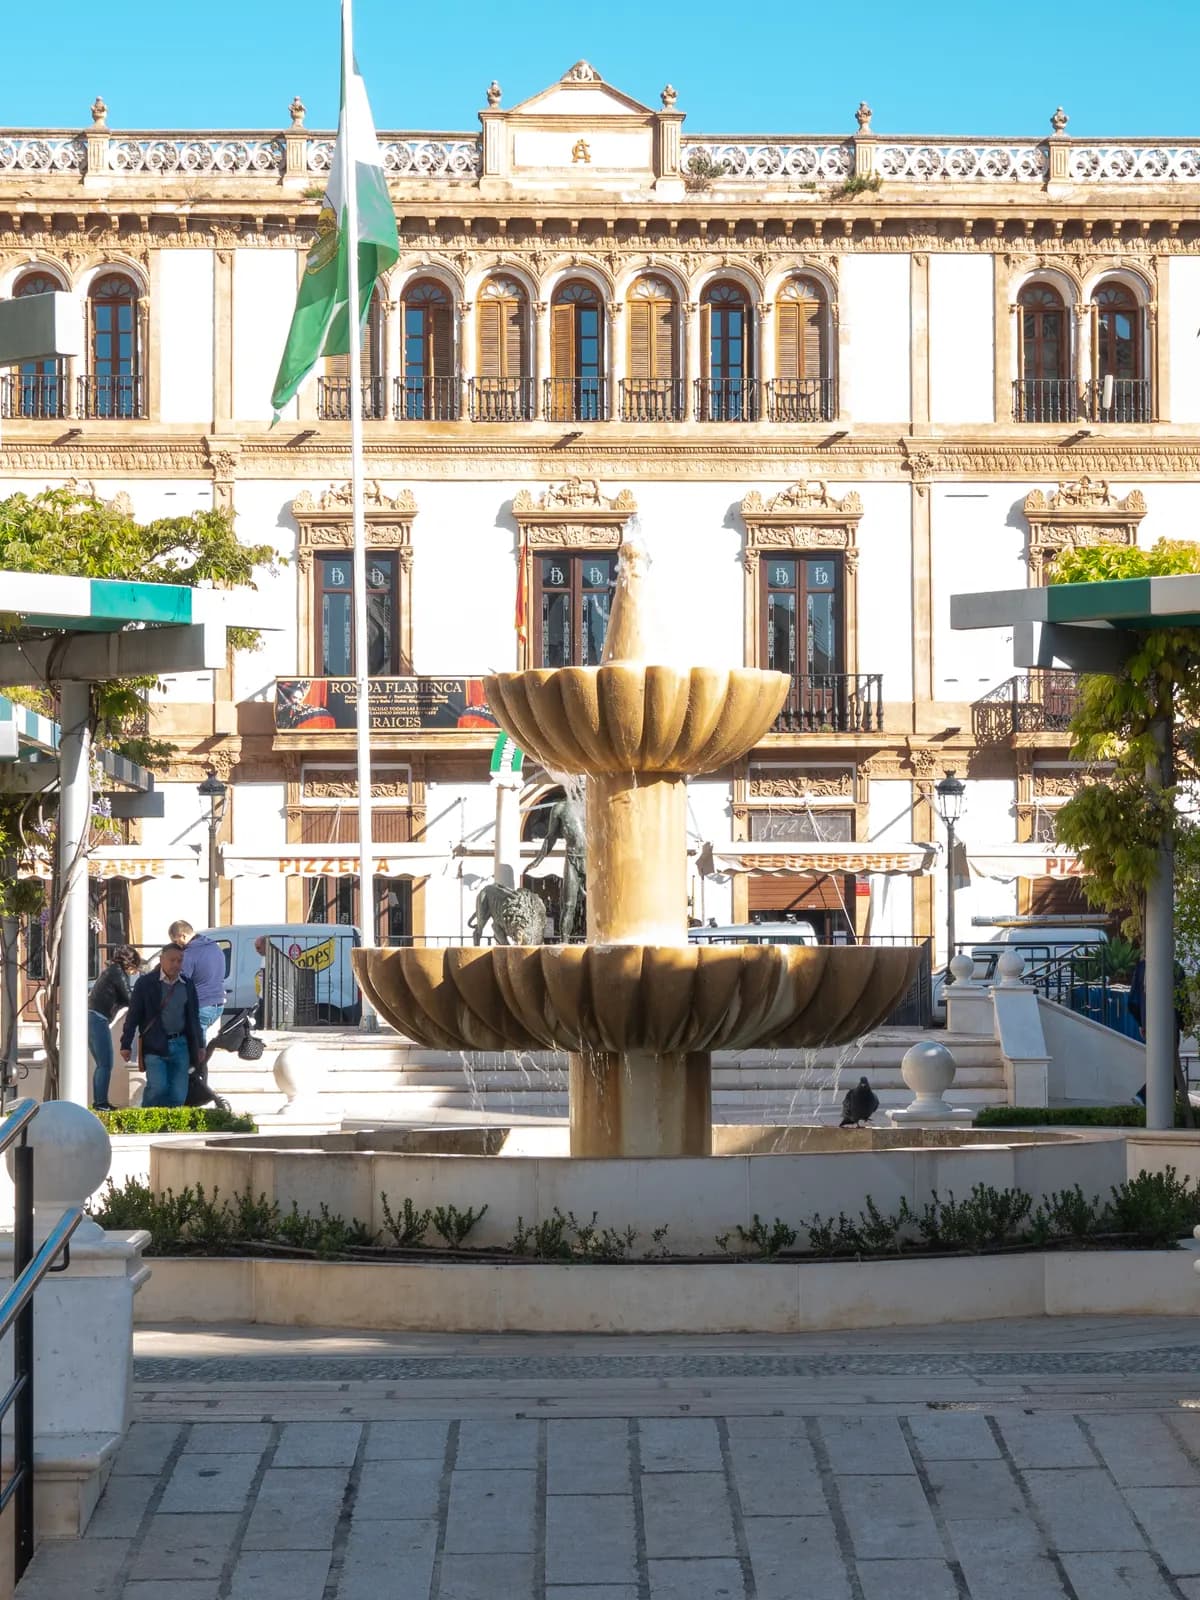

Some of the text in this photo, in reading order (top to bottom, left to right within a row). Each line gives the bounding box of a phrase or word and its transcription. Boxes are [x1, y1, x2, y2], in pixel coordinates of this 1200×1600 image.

[386, 682, 462, 693] FLAMENCA
[373, 717, 421, 728] RAICES
[279, 858, 389, 873] PIZZERA
